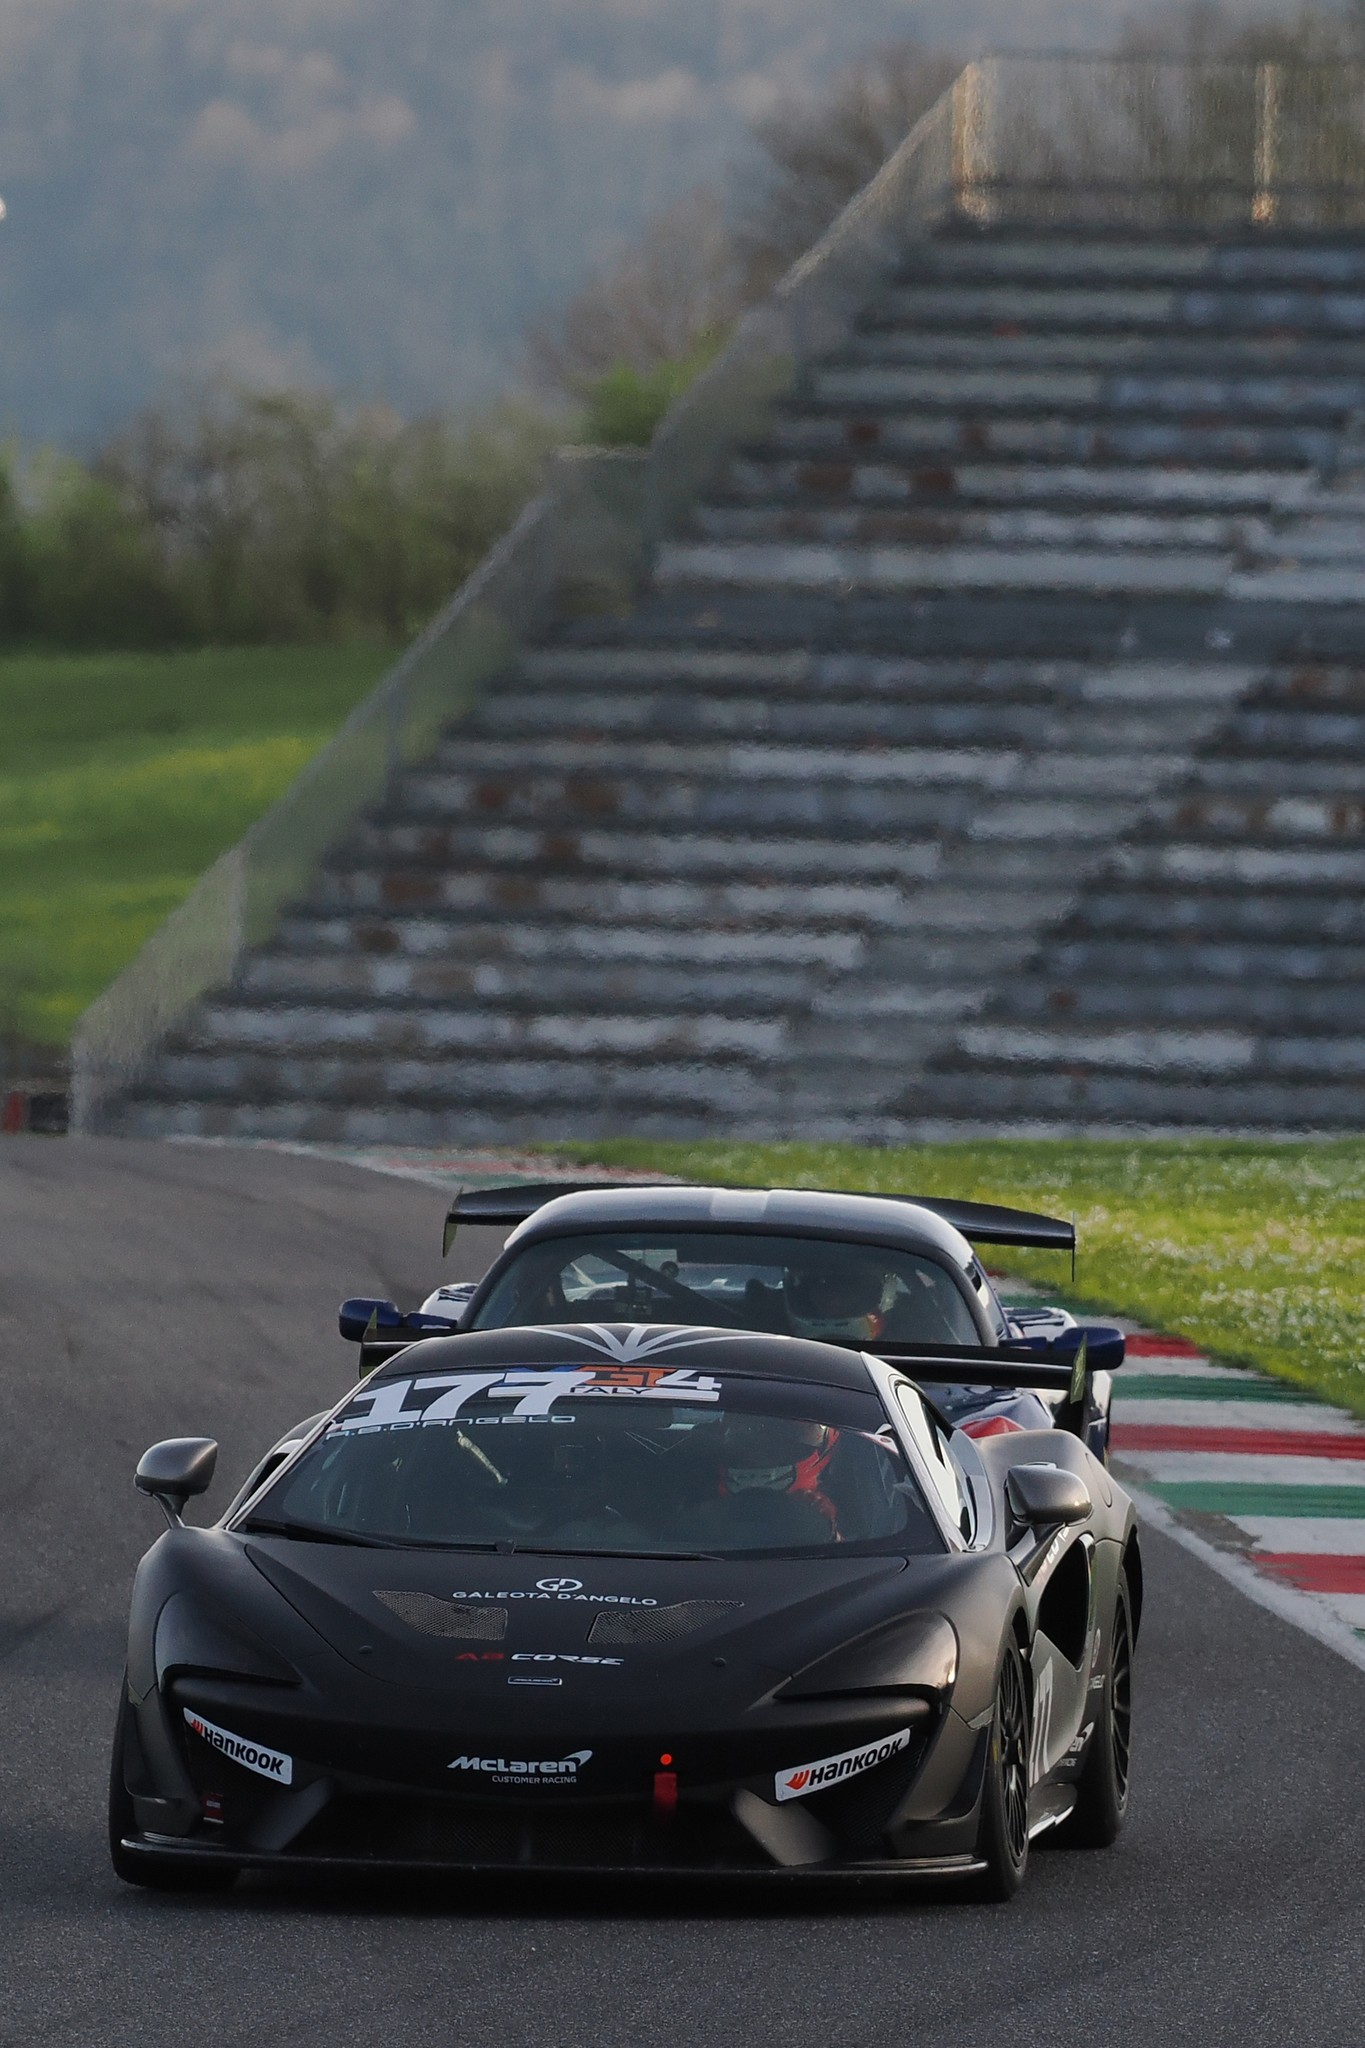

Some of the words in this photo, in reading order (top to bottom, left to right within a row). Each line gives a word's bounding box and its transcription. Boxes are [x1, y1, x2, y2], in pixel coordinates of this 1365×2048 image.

[572, 1365, 723, 1390] GT4
[567, 1386, 651, 1395] TALY
[339, 1371, 597, 1431] 177
[452, 1591, 551, 1600] GALEOTA
[557, 1592, 659, 1606] D'ANGELO
[511, 1653, 625, 1666] CORSE
[446, 1755, 578, 1774] McLaren
[491, 1774, 541, 1784] CUSTOMER
[541, 1775, 578, 1784] RACING
